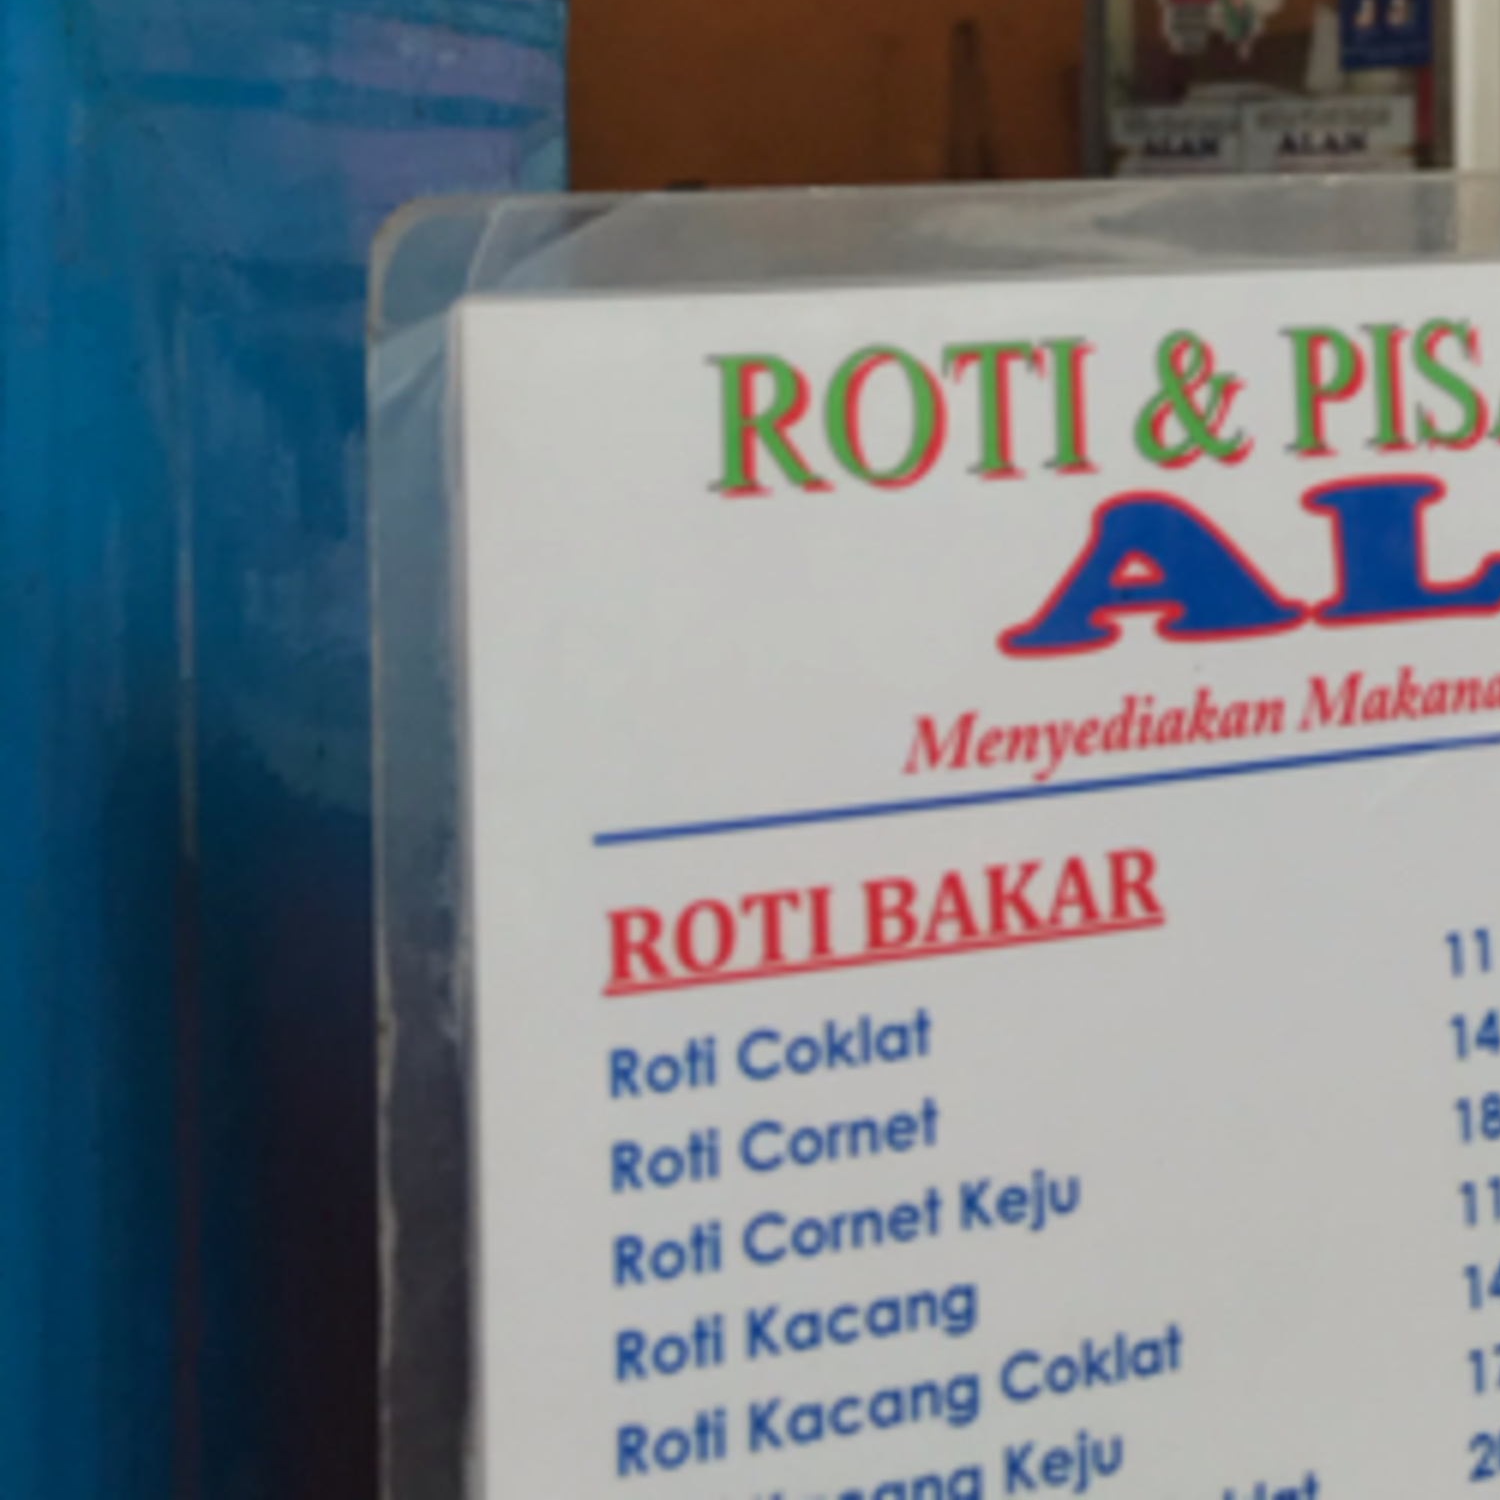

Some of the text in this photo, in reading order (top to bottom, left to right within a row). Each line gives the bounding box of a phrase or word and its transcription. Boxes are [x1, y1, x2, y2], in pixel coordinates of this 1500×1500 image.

[708, 336, 1100, 498] ROTI
[1134, 330, 1255, 470] &
[902, 687, 1286, 783] Menyediakan
[605, 846, 1166, 984] ROTI BAKAR
[1445, 927, 1491, 978] 11
[608, 1009, 933, 1099] Roti Coklat
[610, 1097, 939, 1192] Roti Cornet
[613, 1169, 1080, 1287] Roti Cornet Keju
[614, 1282, 979, 1382] Roti Kacang
[615, 1324, 1183, 1476] Roti Kacang Coklat
[1004, 1429, 1125, 1495] Keju
